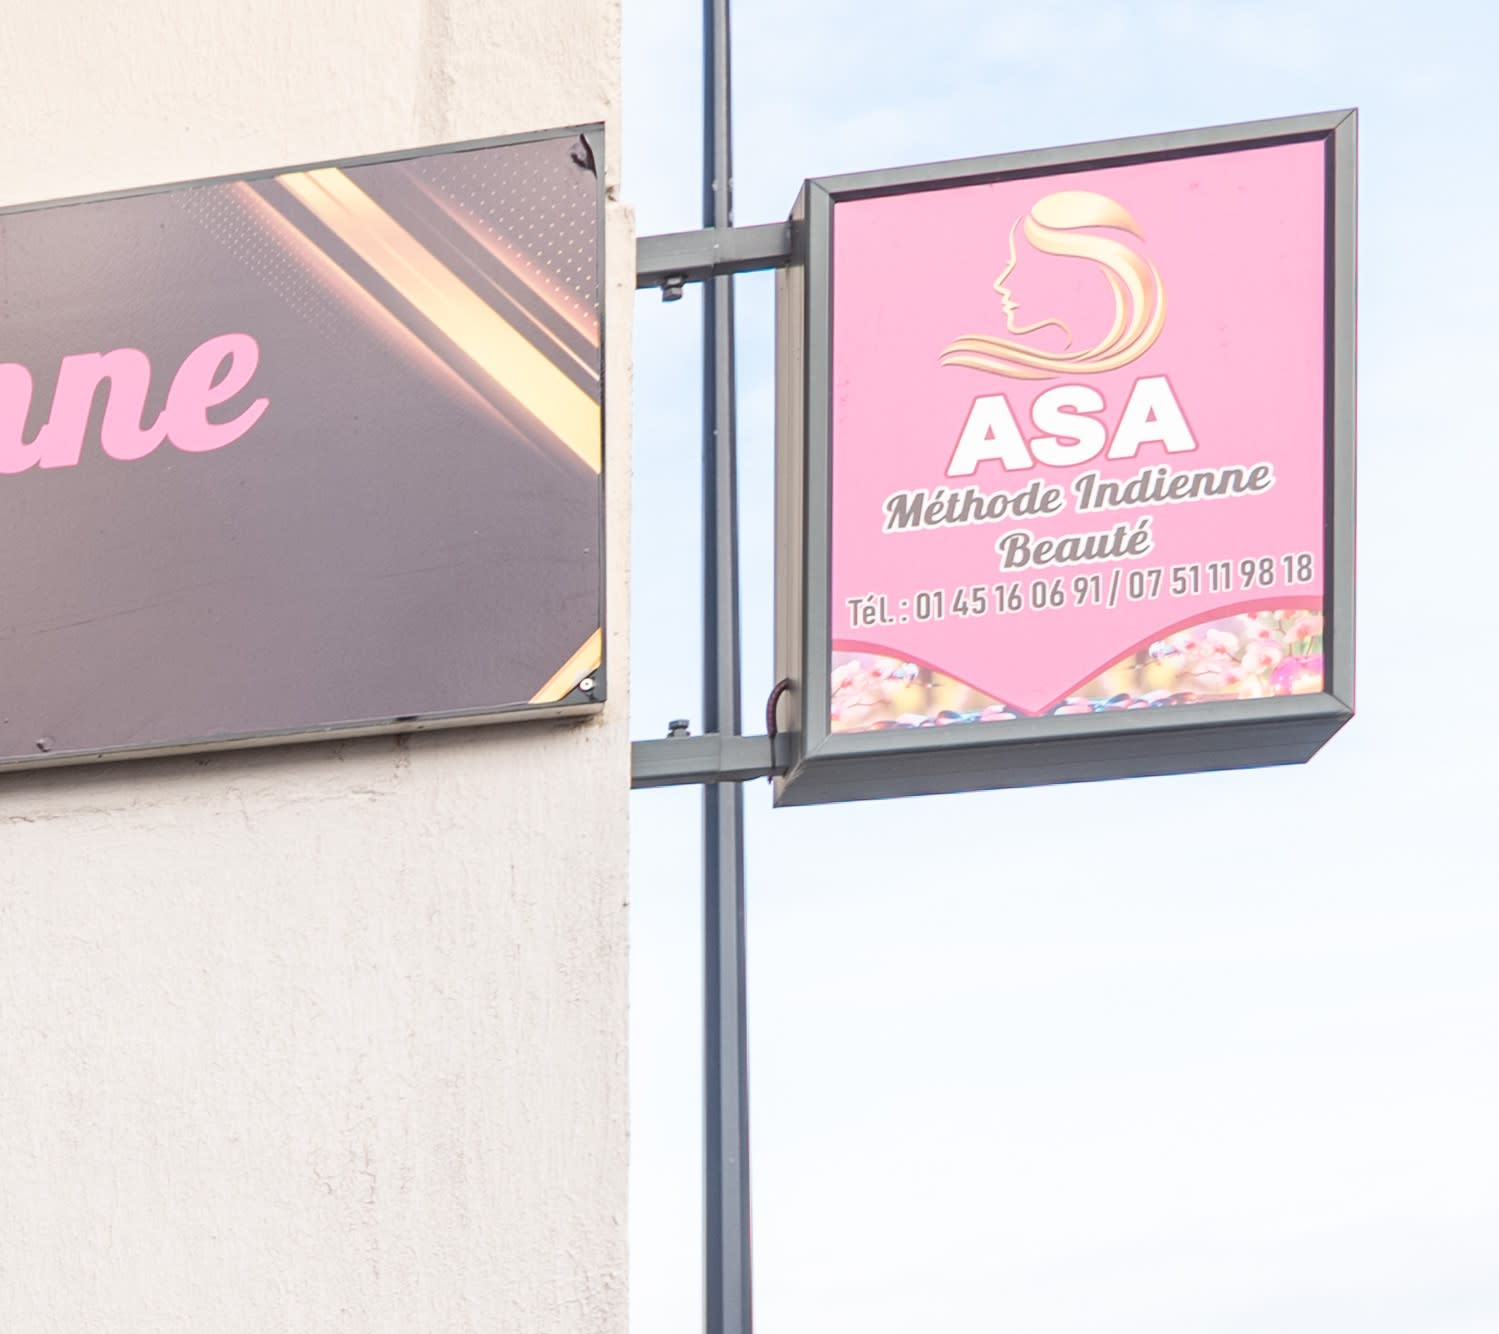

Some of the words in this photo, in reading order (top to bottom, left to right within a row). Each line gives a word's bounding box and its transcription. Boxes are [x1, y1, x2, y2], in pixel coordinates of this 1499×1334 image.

[946, 375, 1198, 477] ASA
[884, 481, 1063, 530] Méthode
[1074, 461, 1273, 511] Indienne
[998, 518, 1151, 569] Beauté
[849, 595, 893, 626] Tél.
[916, 590, 943, 620] 01
[952, 587, 986, 615] 45
[994, 582, 1022, 612] 16
[1032, 579, 1064, 608] 06
[1073, 575, 1101, 606] 91
[1128, 570, 1161, 599] 07
[1172, 565, 1200, 595] 51
[1208, 562, 1231, 590] 11
[1239, 558, 1274, 587] 98
[1283, 554, 1313, 582] 18
